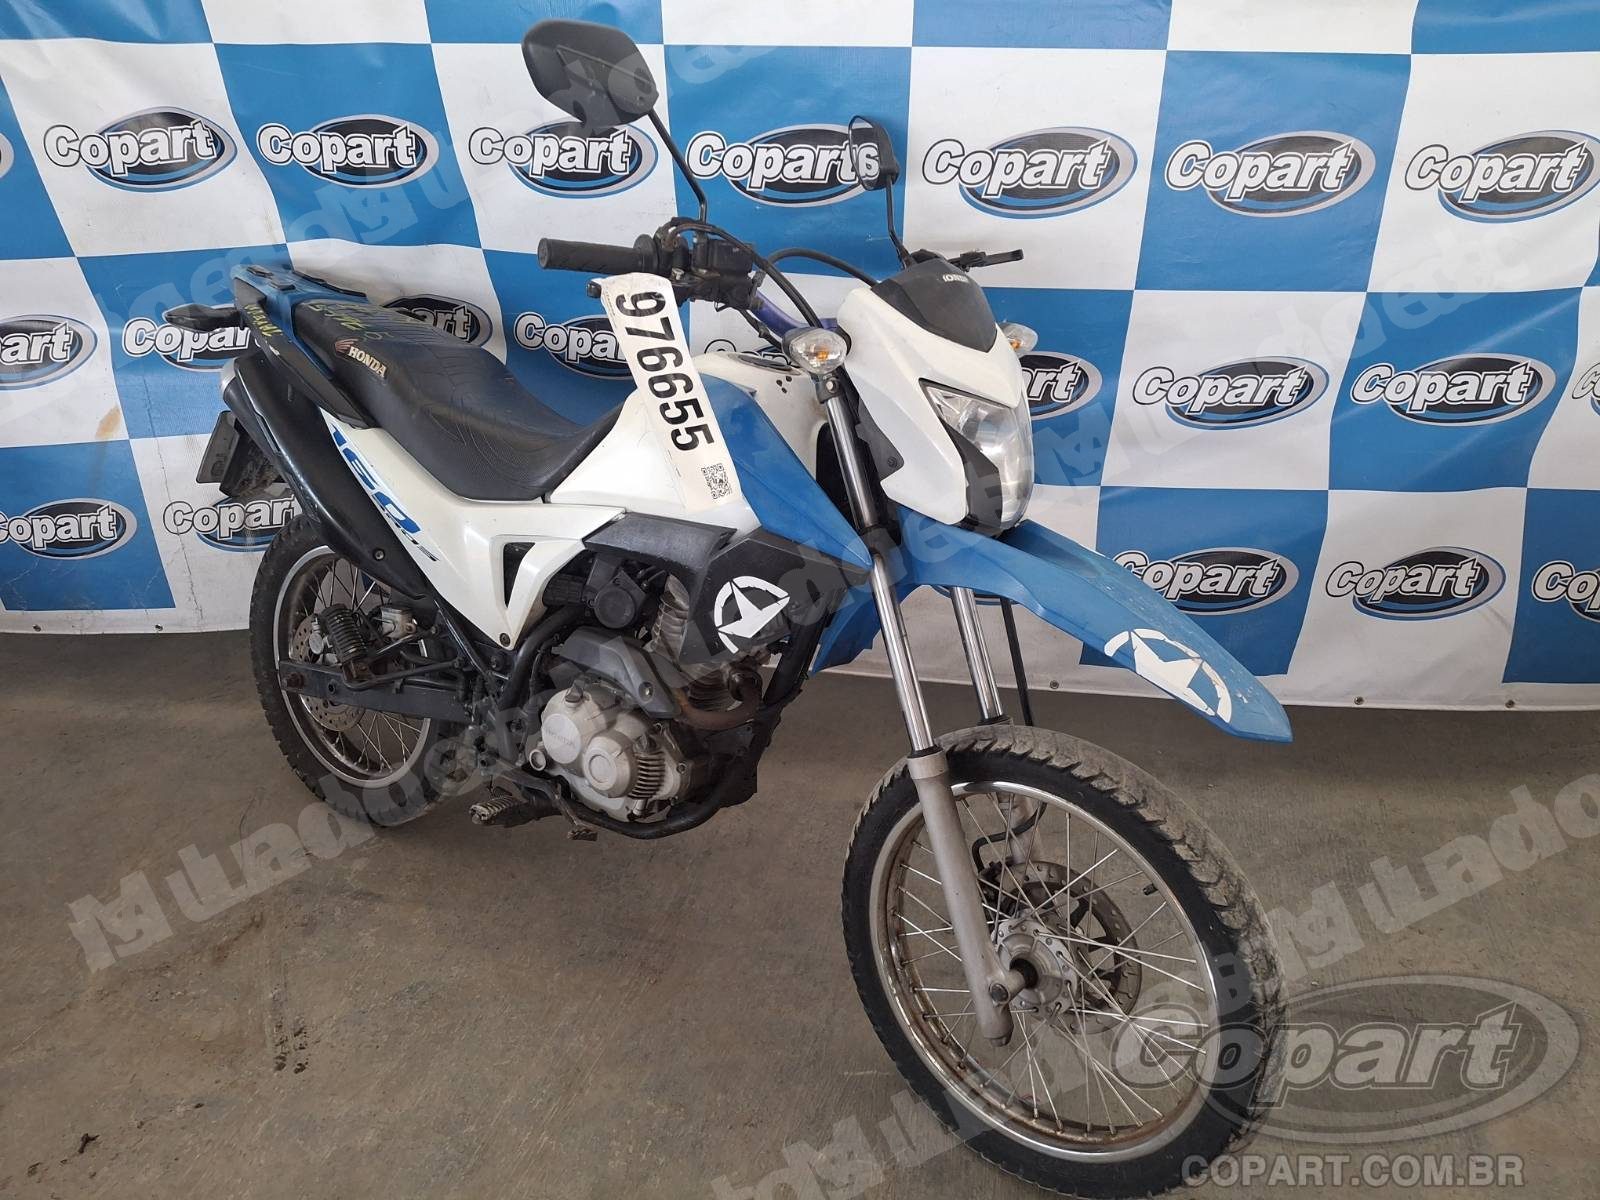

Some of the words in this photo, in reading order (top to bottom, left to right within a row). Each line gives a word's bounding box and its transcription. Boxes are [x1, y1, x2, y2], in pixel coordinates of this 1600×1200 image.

[43, 119, 218, 177] Copart
[257, 122, 418, 174] Copart
[469, 126, 633, 178] Copart
[687, 130, 858, 189] Copart
[922, 137, 1112, 198] Copart
[1165, 140, 1355, 202] Copart
[1404, 141, 1588, 203] Copart
[0, 321, 73, 365] art
[122, 317, 250, 362] Copar
[411, 304, 471, 341] art
[513, 312, 628, 363] Copa
[347, 346, 388, 379] HONDA
[615, 291, 715, 452] 976655
[1351, 360, 1534, 413] Copart
[1132, 364, 1308, 415] Copart
[1325, 556, 1479, 603] Copart
